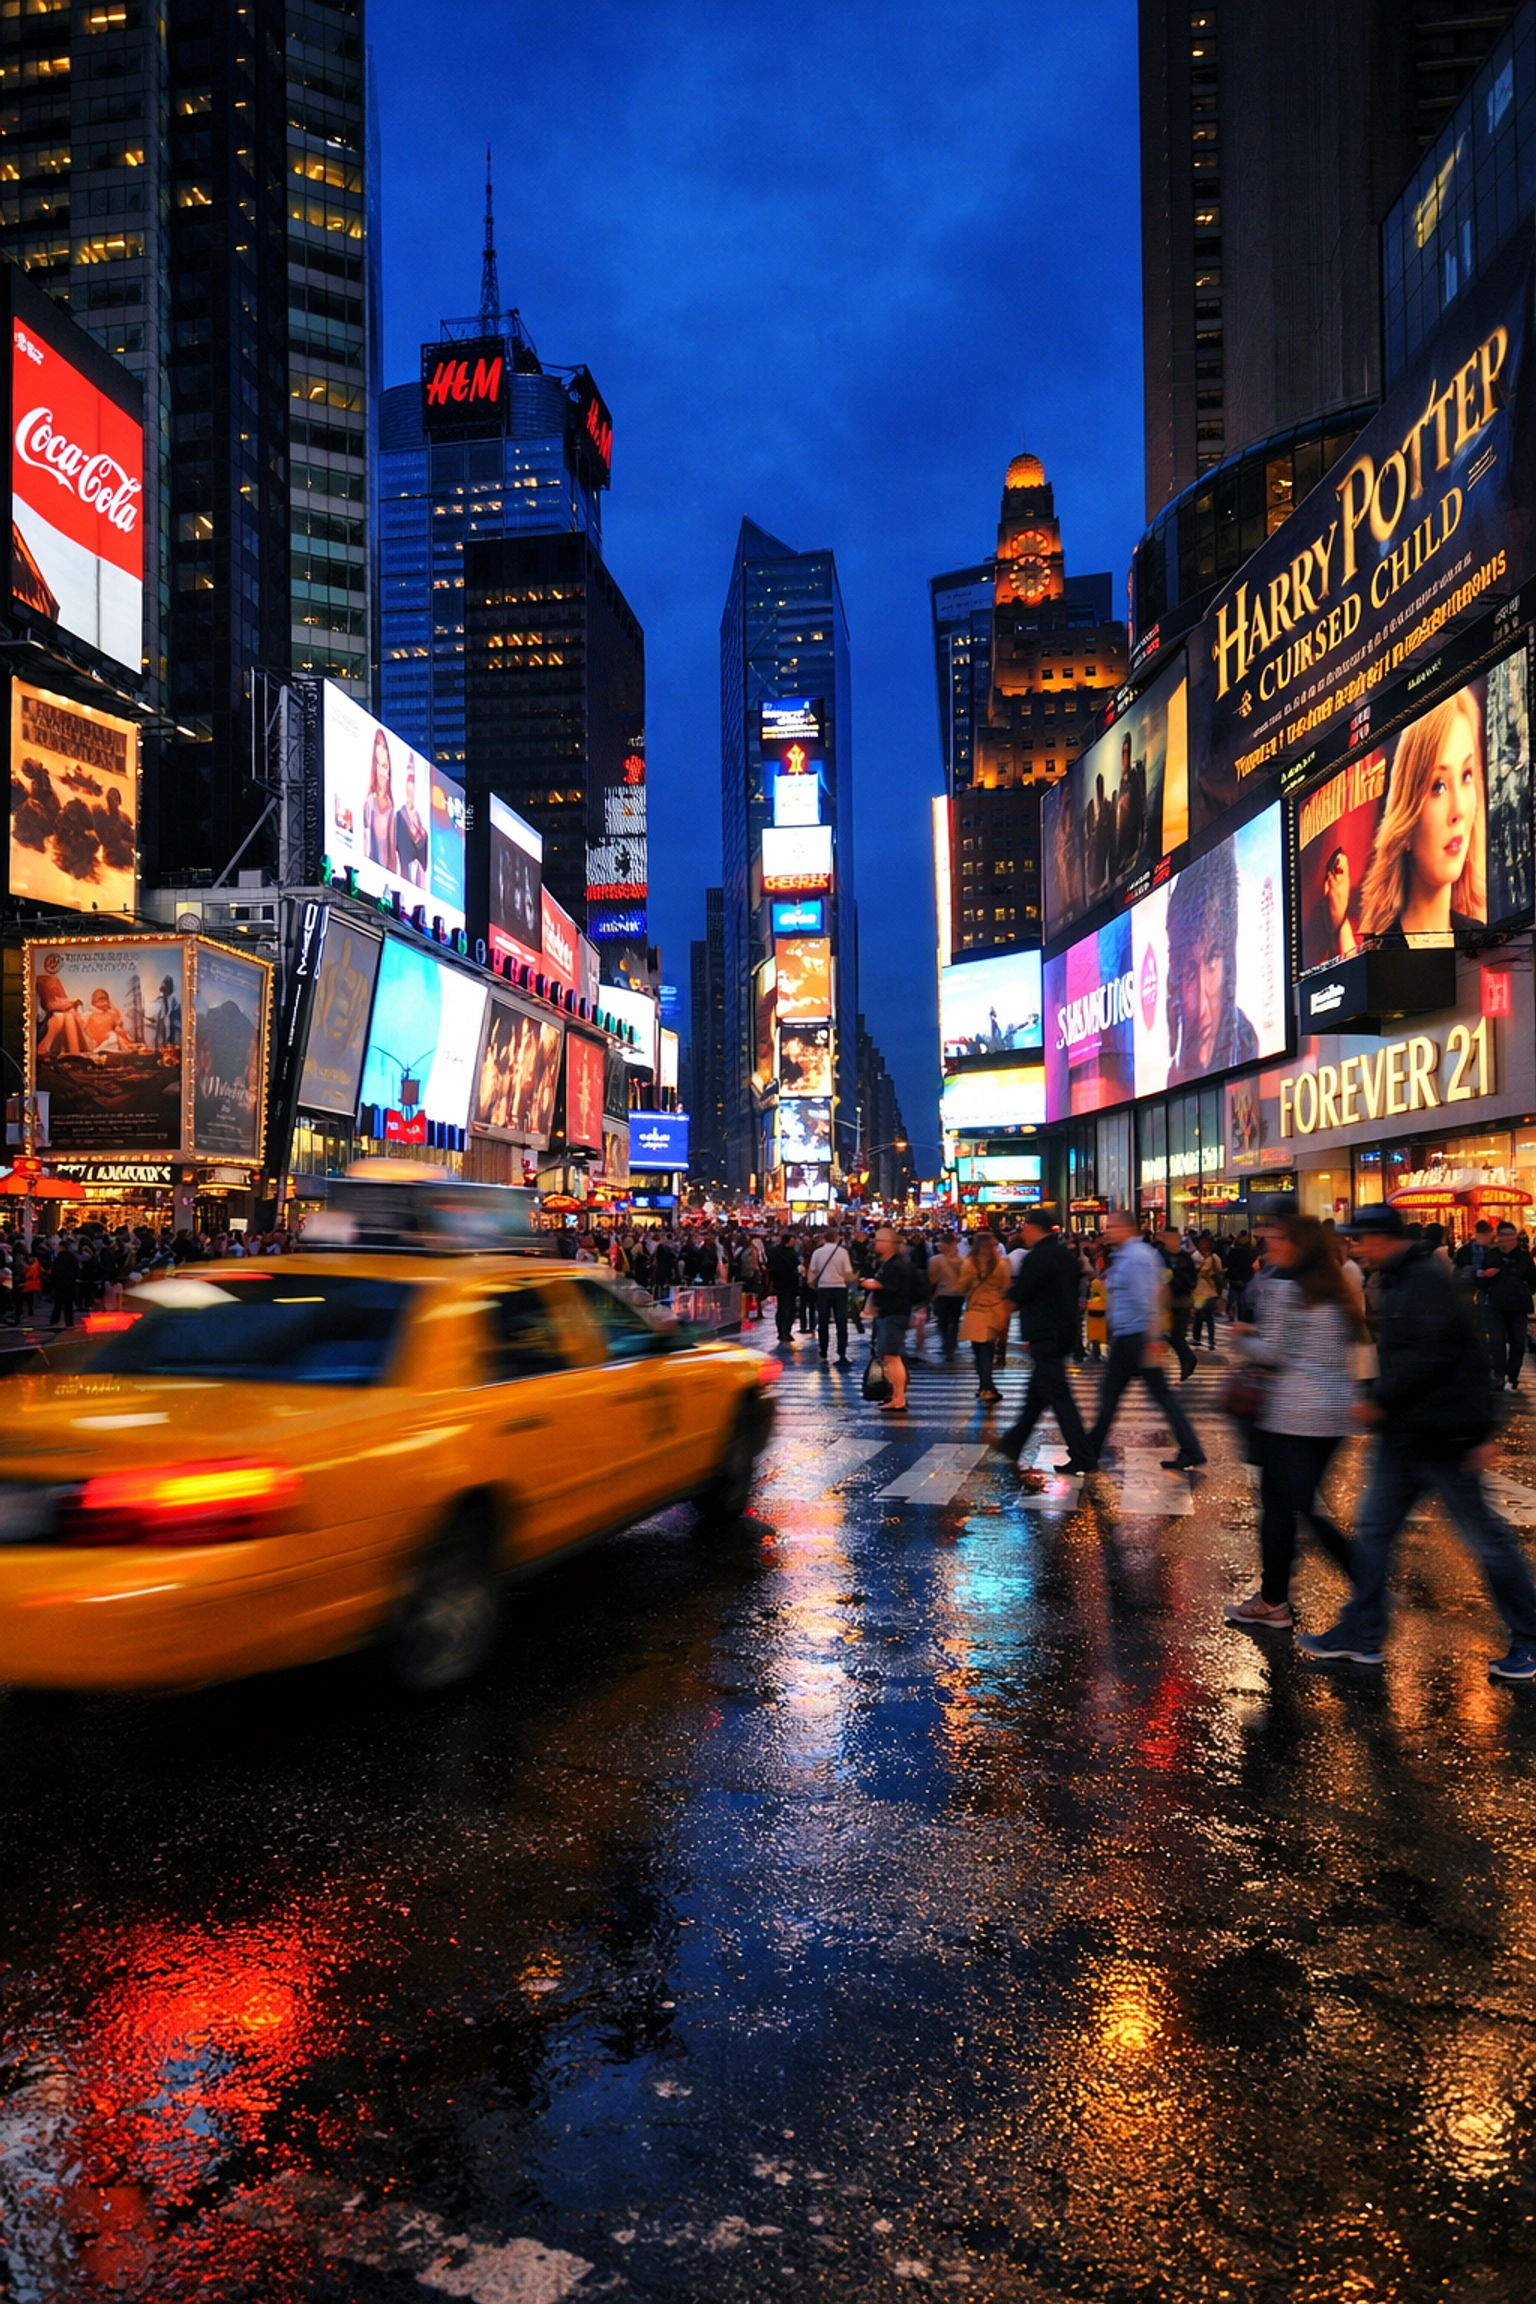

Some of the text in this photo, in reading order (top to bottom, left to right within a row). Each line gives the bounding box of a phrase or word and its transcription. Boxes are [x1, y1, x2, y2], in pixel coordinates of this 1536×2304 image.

[427, 357, 502, 405] H&M
[15, 407, 142, 533] Coca-Cola
[1212, 518, 1338, 701] HARRY
[1370, 487, 1464, 611] CHILD
[1280, 1016, 1498, 1138] FOREVER 21
